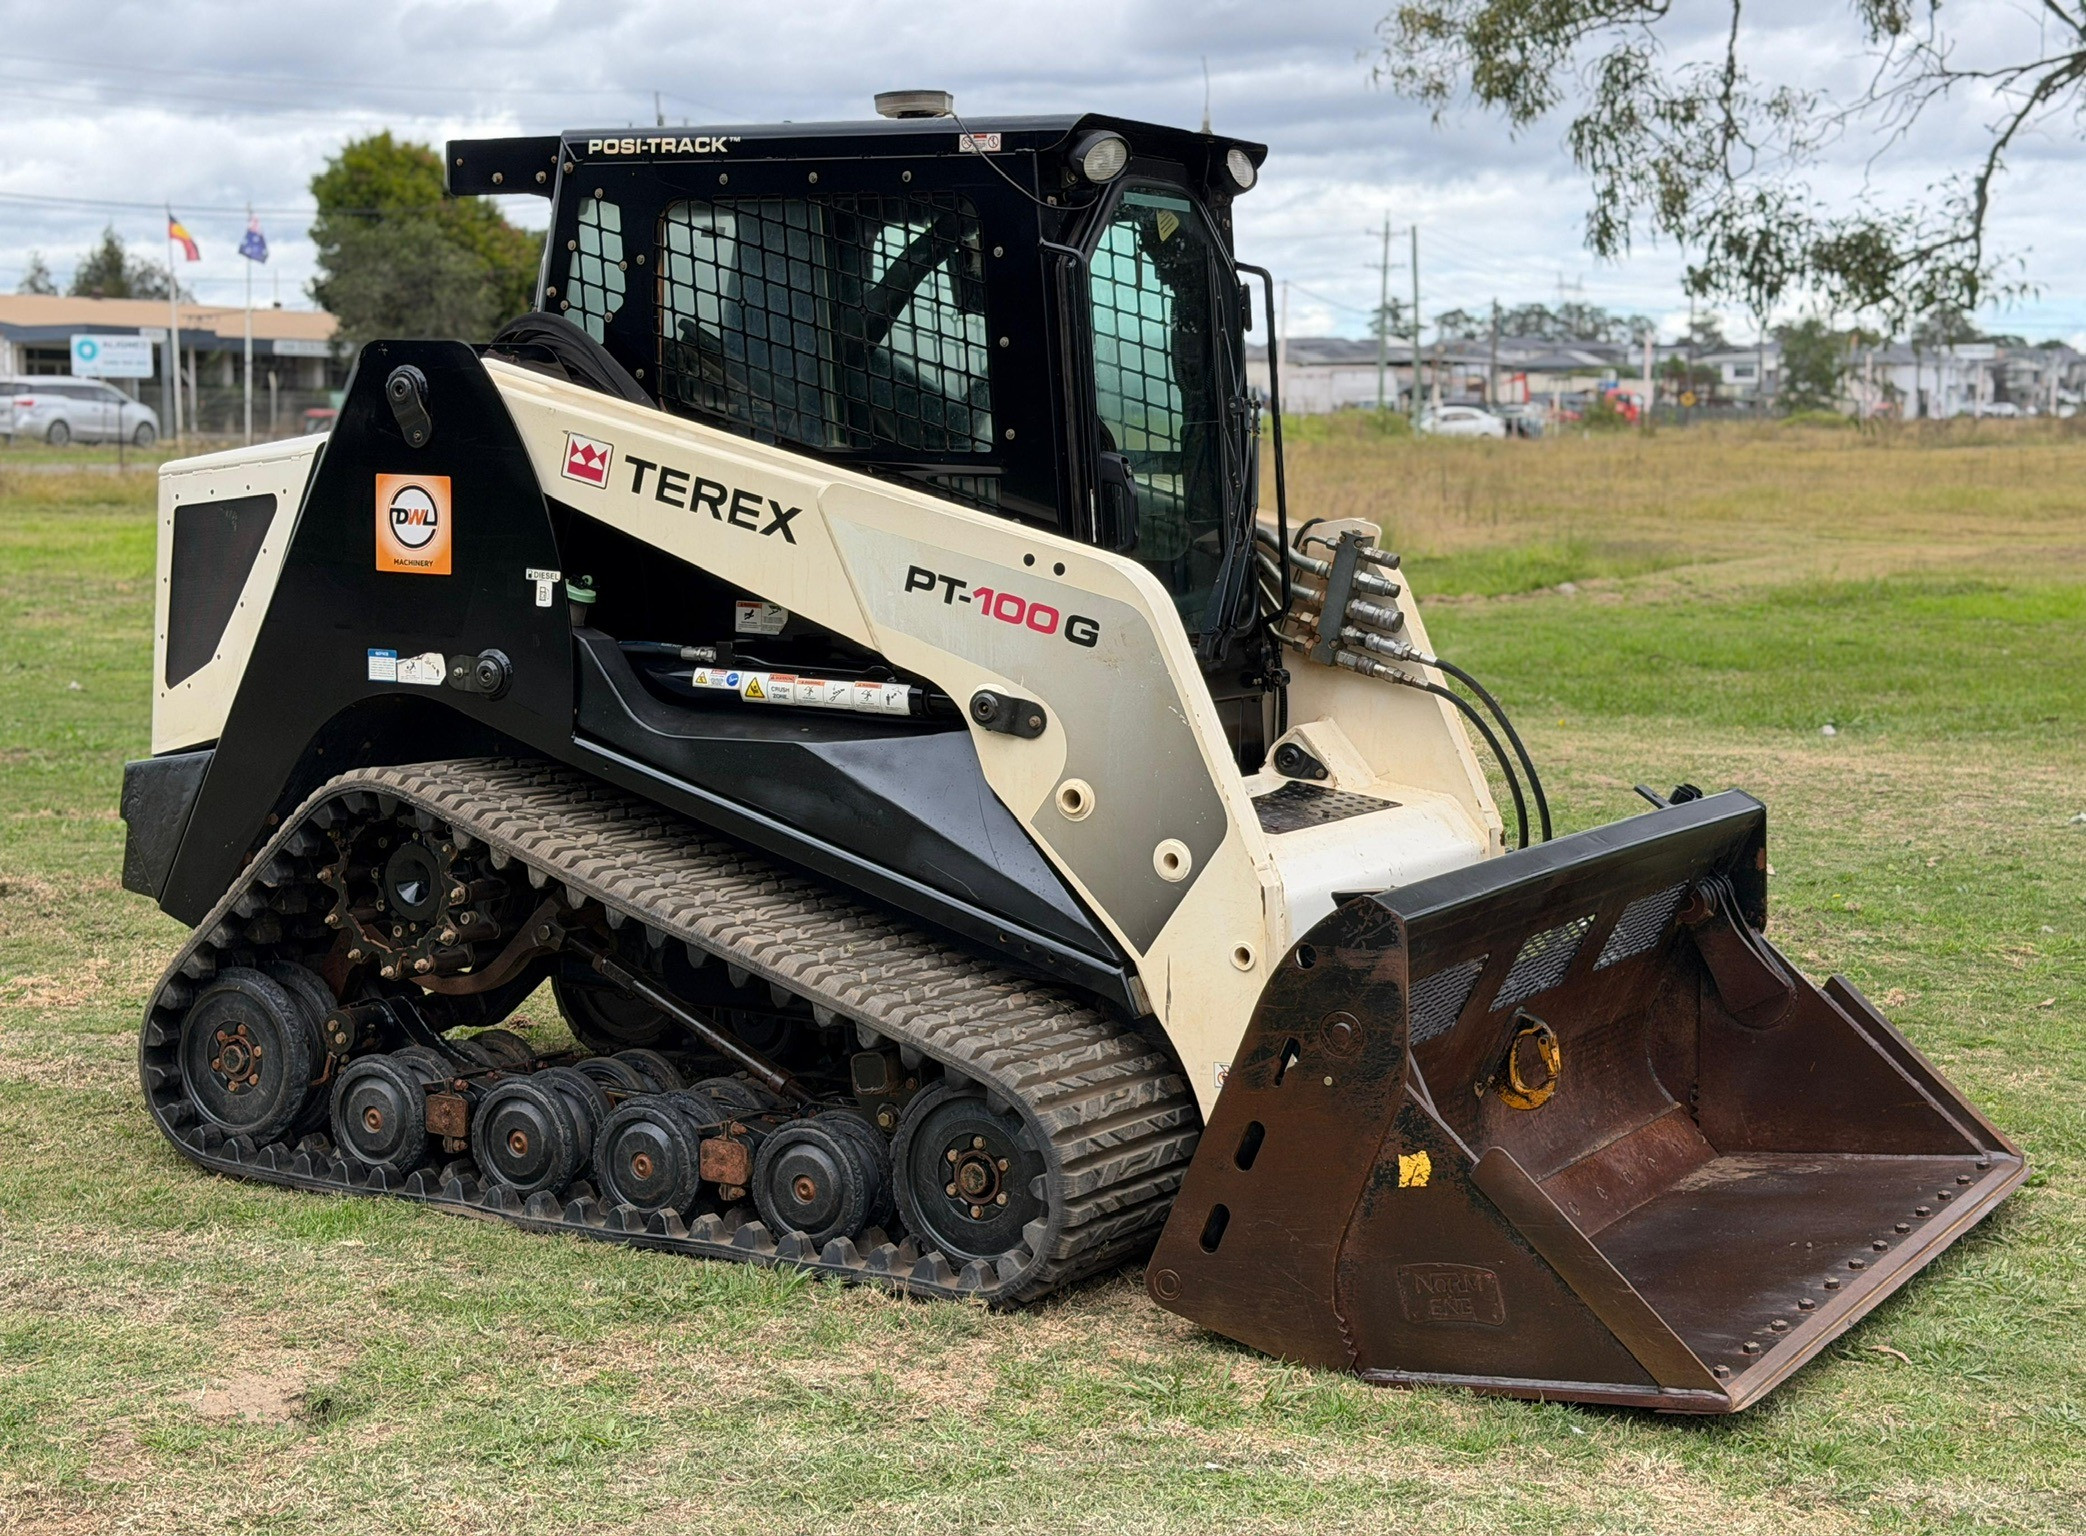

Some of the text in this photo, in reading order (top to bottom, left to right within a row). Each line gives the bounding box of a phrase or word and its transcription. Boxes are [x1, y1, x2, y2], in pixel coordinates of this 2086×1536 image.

[625, 454, 803, 545] TEREX
[389, 507, 438, 526] DWL
[393, 558, 434, 567] MACHINERY
[533, 571, 559, 580] DIESEL
